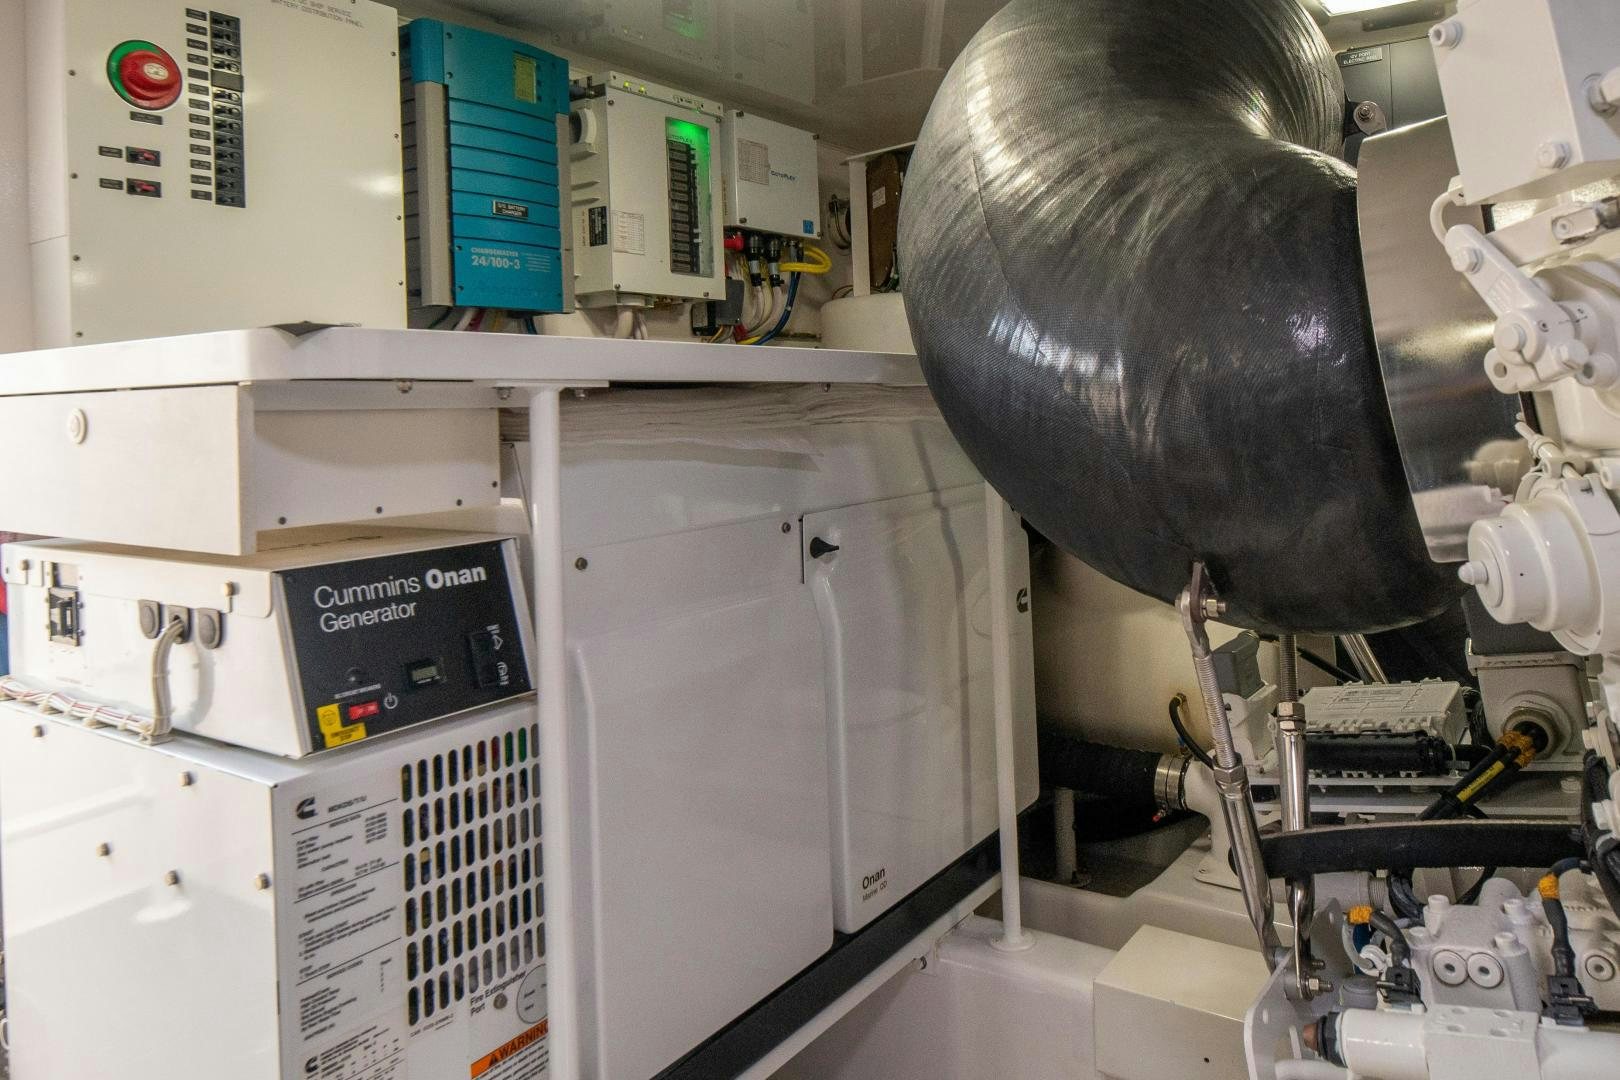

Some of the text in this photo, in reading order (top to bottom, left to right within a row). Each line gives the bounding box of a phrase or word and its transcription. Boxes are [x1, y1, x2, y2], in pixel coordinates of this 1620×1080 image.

[471, 255, 521, 270] 24/100-3
[314, 566, 487, 608] Cummins Onan
[320, 601, 417, 633] Generator
[862, 869, 886, 889] Onan
[470, 994, 484, 1006] Fire
[470, 1003, 486, 1017] Port
